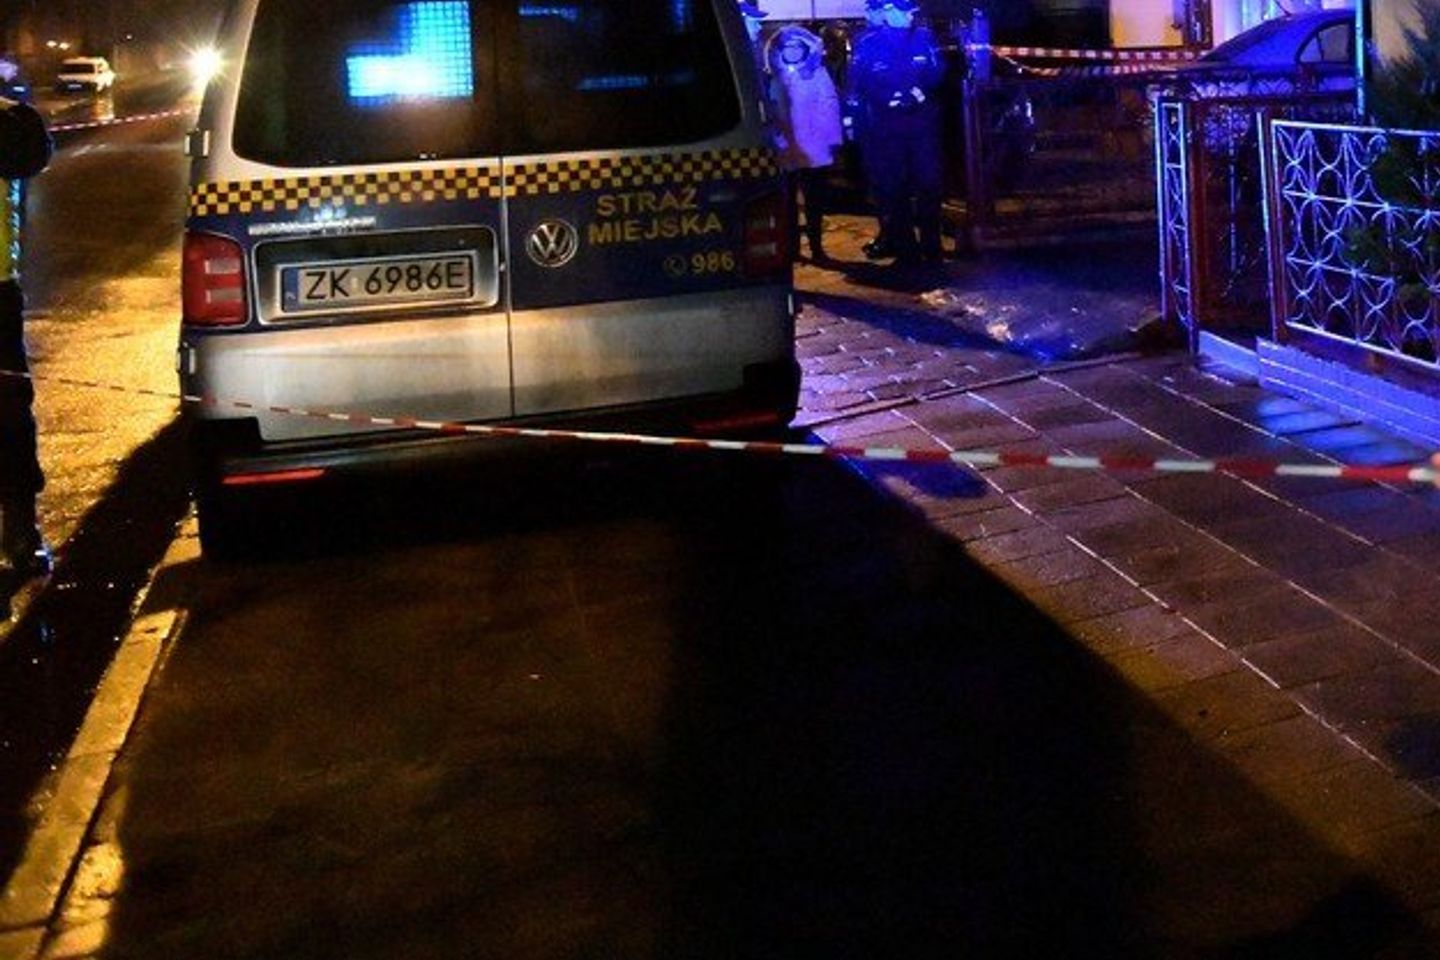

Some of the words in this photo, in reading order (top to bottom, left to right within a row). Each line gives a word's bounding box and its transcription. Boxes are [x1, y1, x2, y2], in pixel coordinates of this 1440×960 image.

[597, 184, 698, 217] STRAŻ
[588, 212, 723, 246] MIEJSKA
[691, 250, 736, 274] 986
[306, 270, 349, 300] ZK
[364, 260, 466, 296] 6986E
